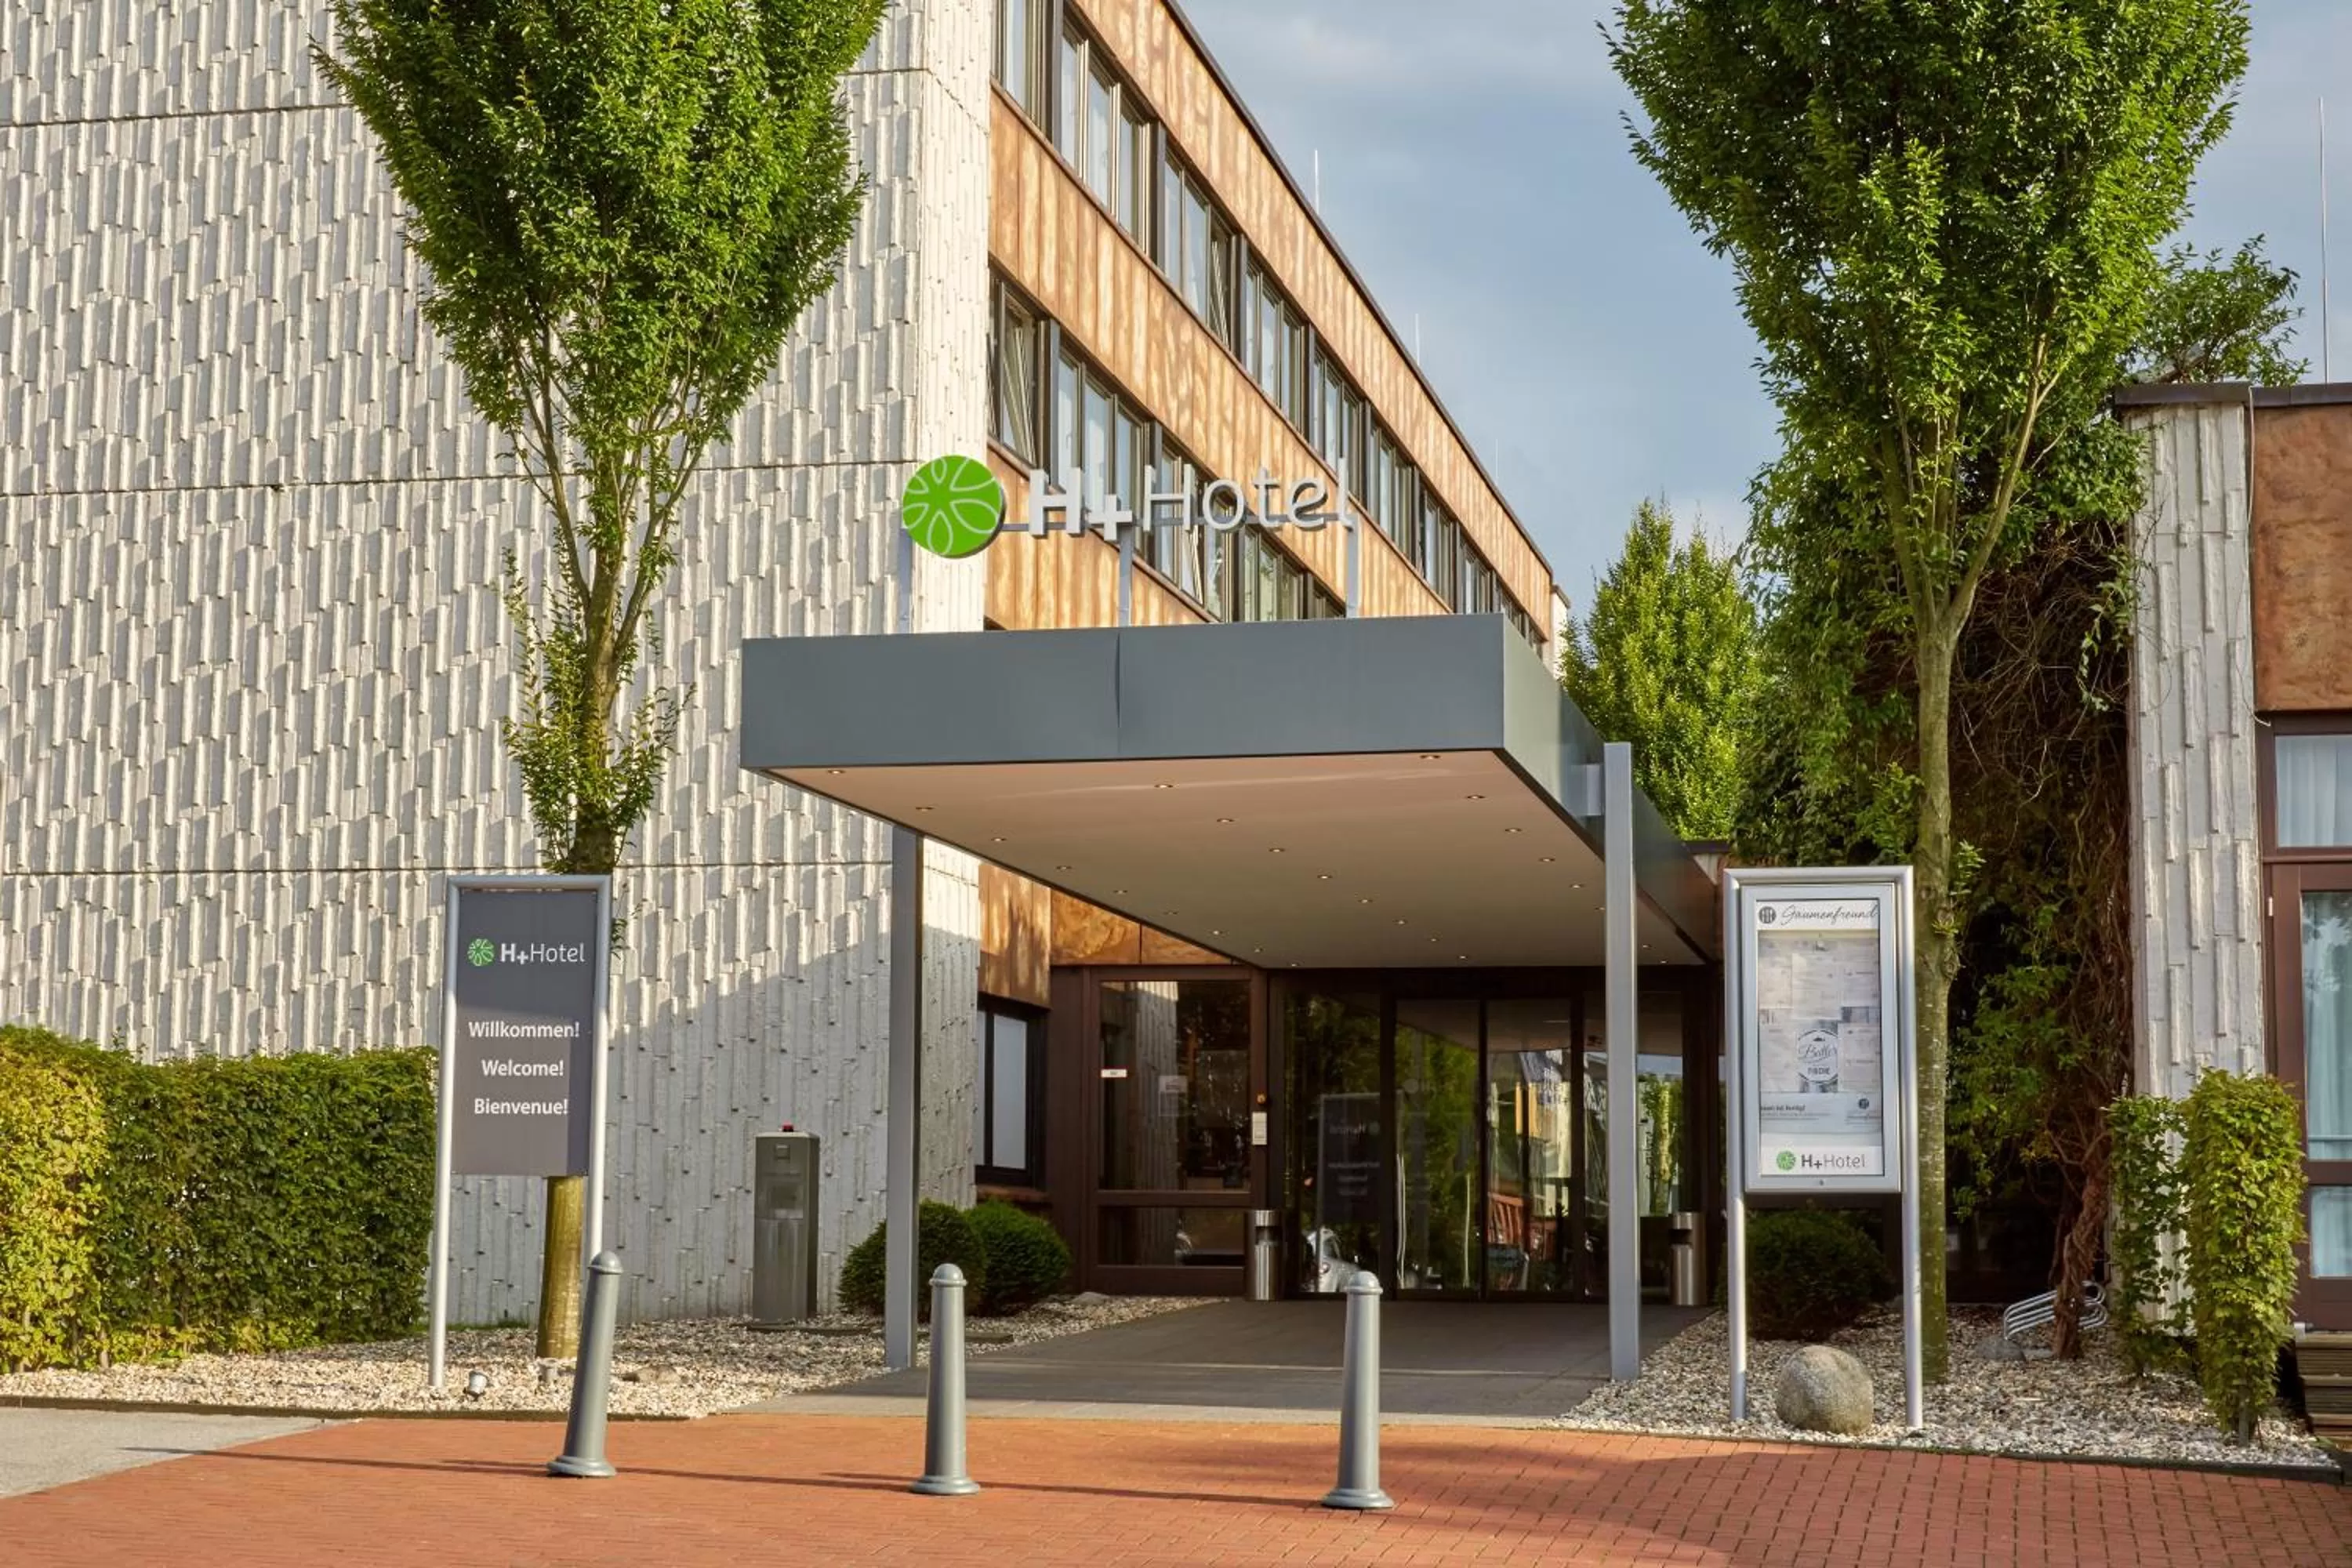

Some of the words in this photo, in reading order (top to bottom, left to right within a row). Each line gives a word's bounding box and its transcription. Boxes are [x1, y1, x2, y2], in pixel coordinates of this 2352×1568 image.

[1027, 457, 1356, 543] H+Hotel
[501, 942, 586, 965] H+Hotel
[468, 1020, 580, 1038] Willkommen!
[481, 1058, 564, 1076] Welcome!
[474, 1098, 568, 1115] Bienvenue!
[1801, 1152, 1866, 1170] H+Hotel
